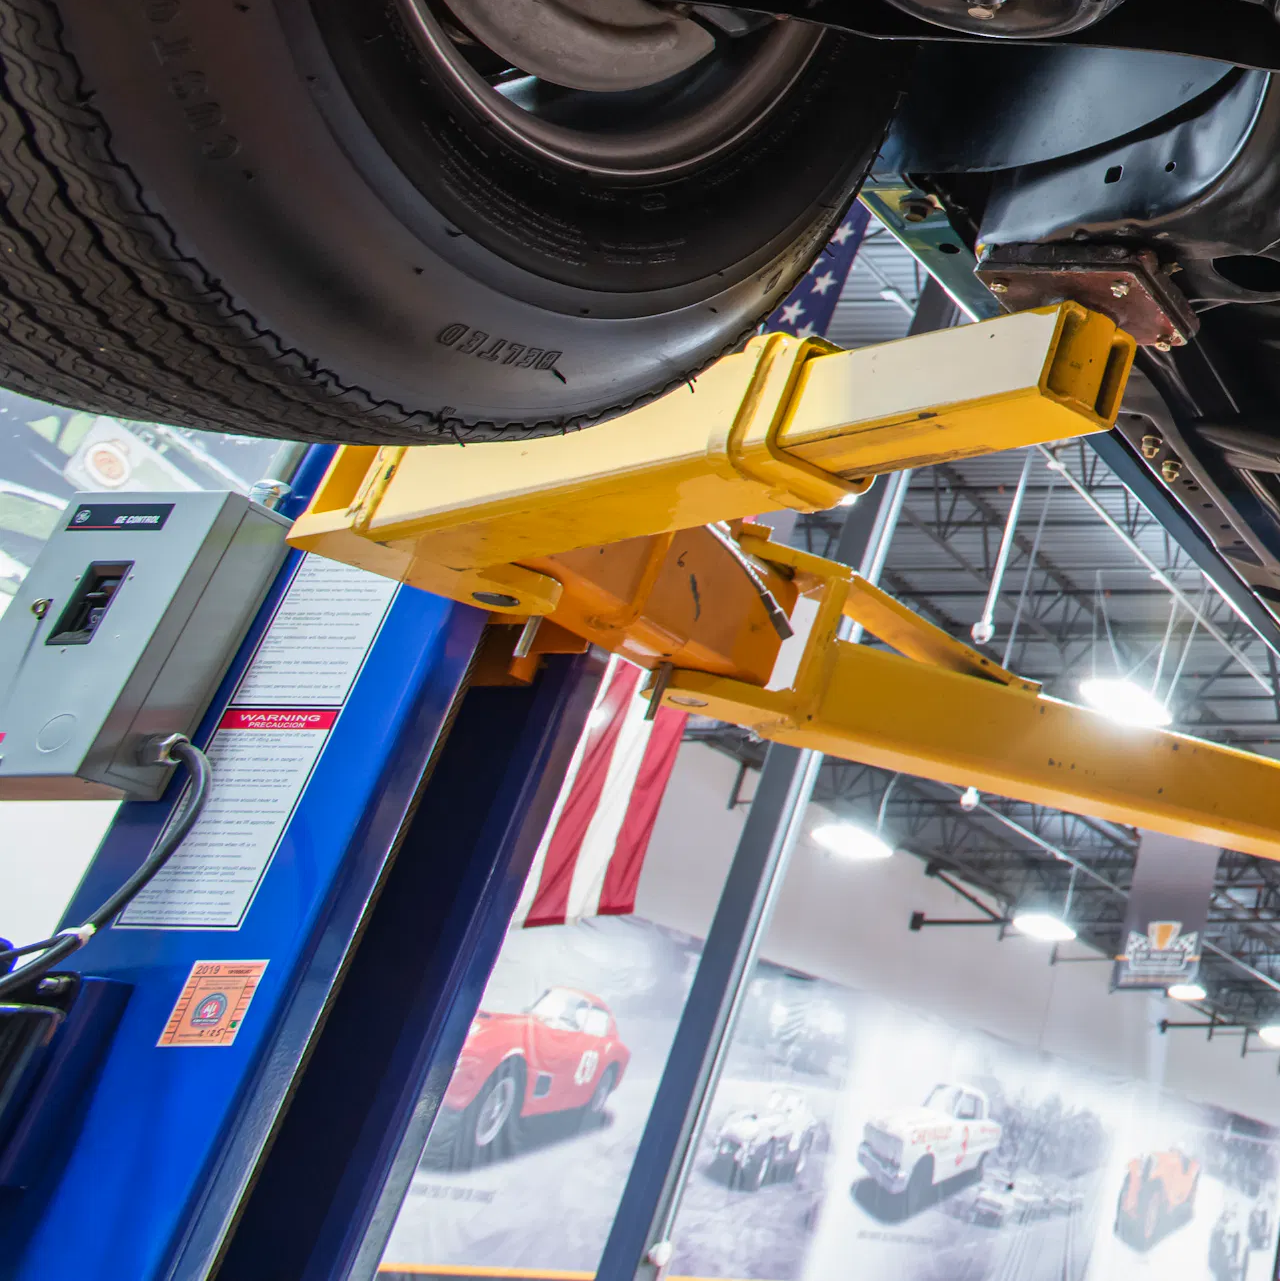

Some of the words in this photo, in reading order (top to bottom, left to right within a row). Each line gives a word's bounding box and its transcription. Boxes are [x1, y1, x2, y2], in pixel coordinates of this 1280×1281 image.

[435, 322, 563, 370] BELTED
[114, 515, 128, 524] GE
[125, 515, 160, 524] CONTROL
[240, 714, 321, 722] WARNING
[196, 965, 221, 975] 2019
